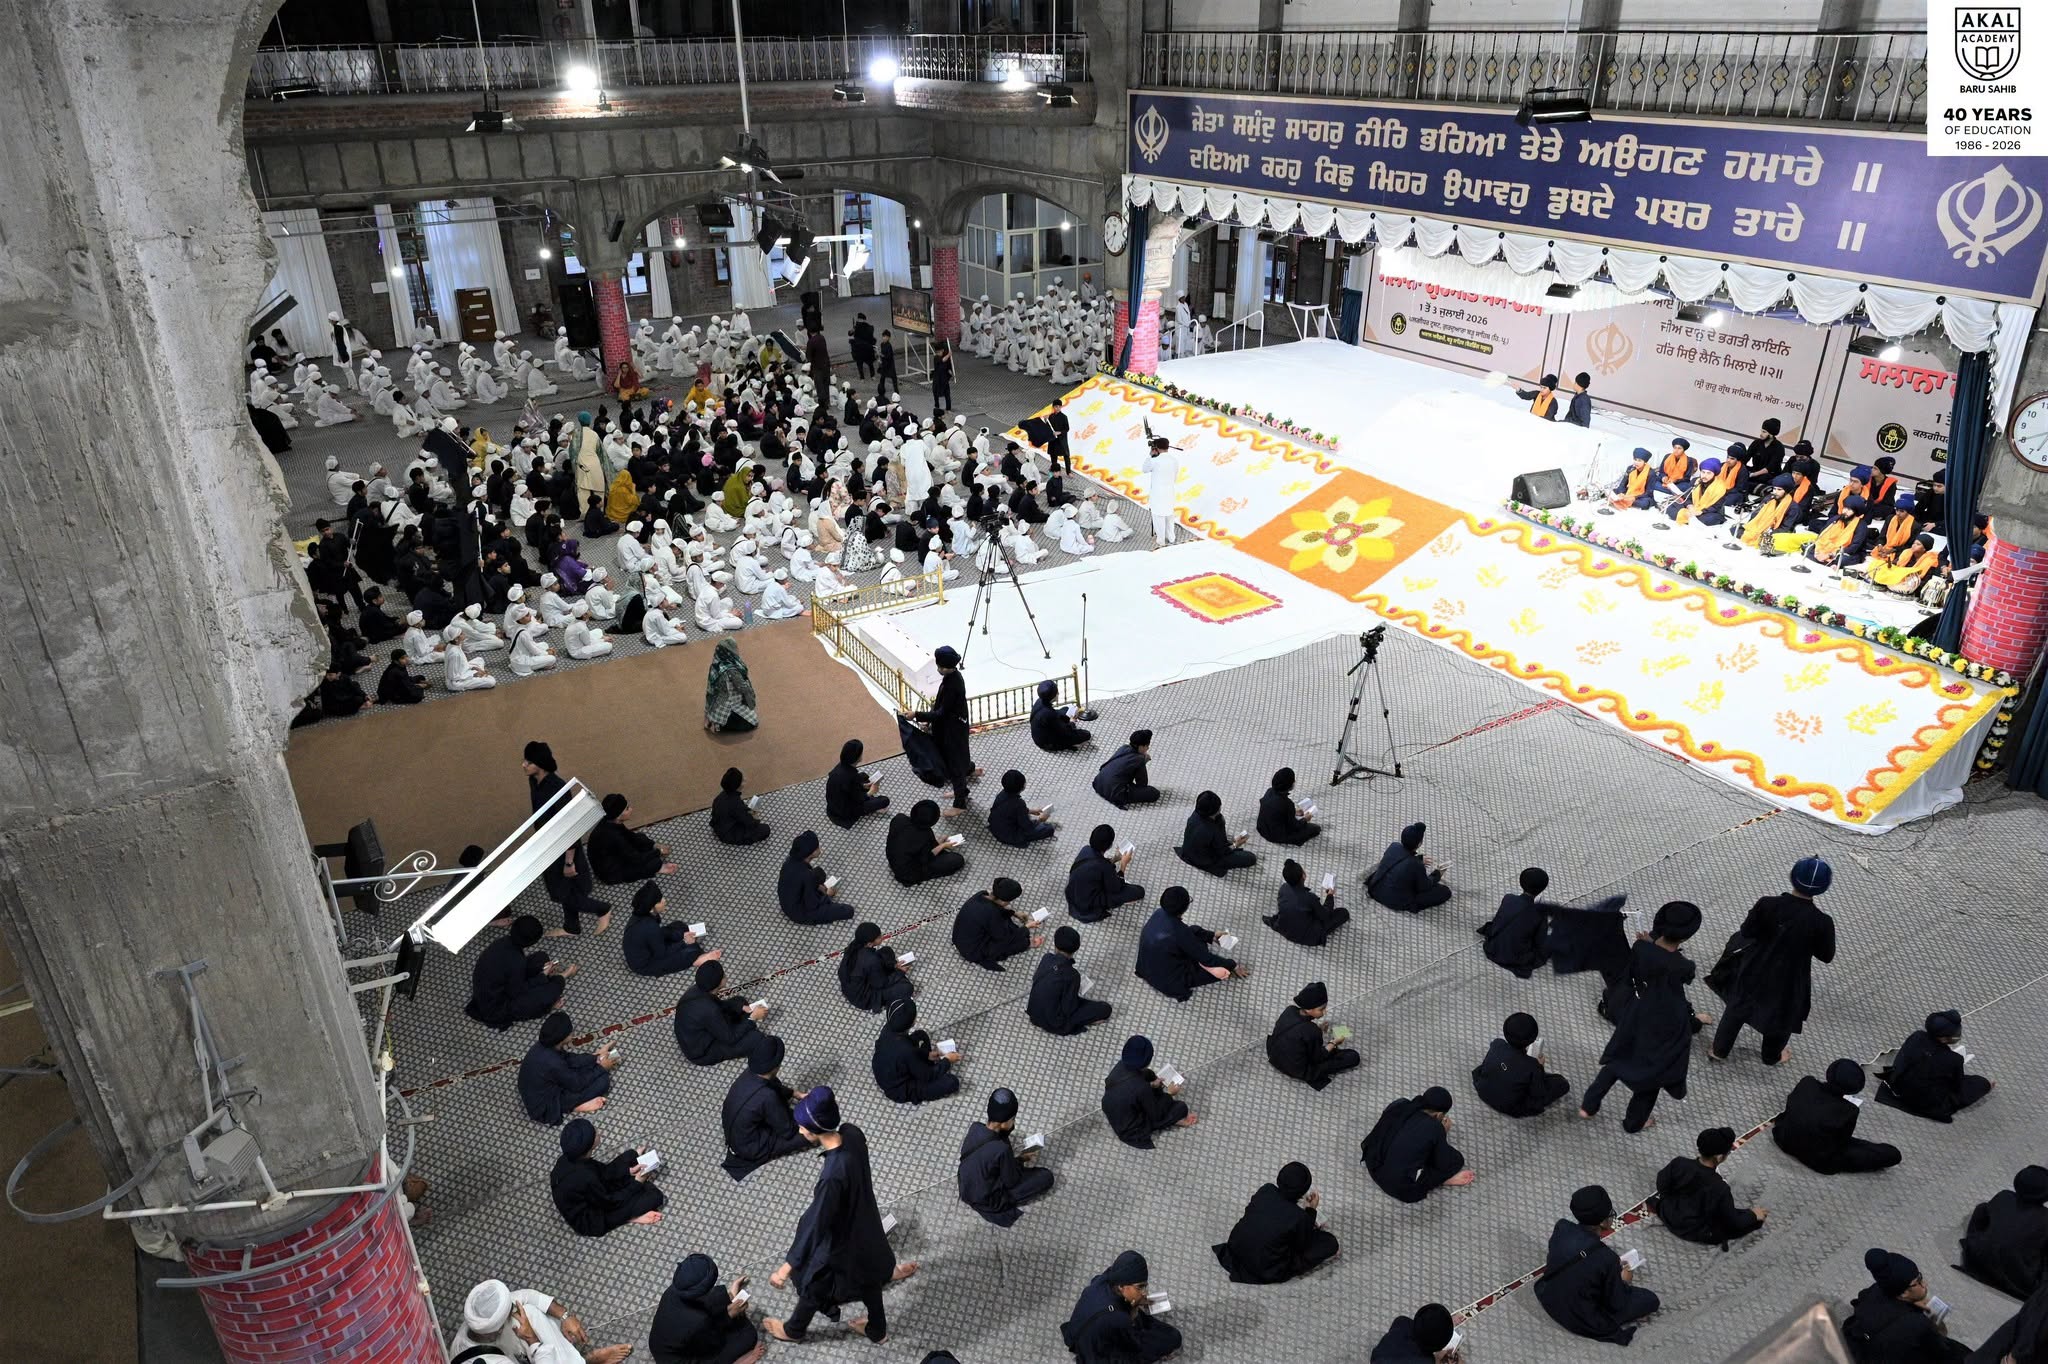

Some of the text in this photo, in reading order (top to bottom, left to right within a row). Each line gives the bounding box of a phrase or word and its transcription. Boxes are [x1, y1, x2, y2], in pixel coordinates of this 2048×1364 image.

[1192, 105, 1224, 132] ਜੇਤਾ
[1285, 119, 1345, 150] ਸਾਗਰੁ
[1356, 117, 1408, 149] ਨੀਰਿ
[1420, 122, 1507, 158] ਭਰਿਆ
[1520, 126, 1564, 162] ਤੇਤੇ
[1578, 134, 1707, 177] ਅਉਗਣ
[1724, 146, 1824, 186] ਹਮਾਰੇ
[1190, 144, 1250, 174] ਦਇਆ
[1261, 157, 1302, 186] ਕਰਹੁ
[1369, 161, 1427, 196] ਮਿਹਰ
[1635, 196, 1712, 230] ਪਥਰ
[1732, 202, 1806, 242] ਤਾਰੇ
[1466, 314, 1488, 325] 2026
